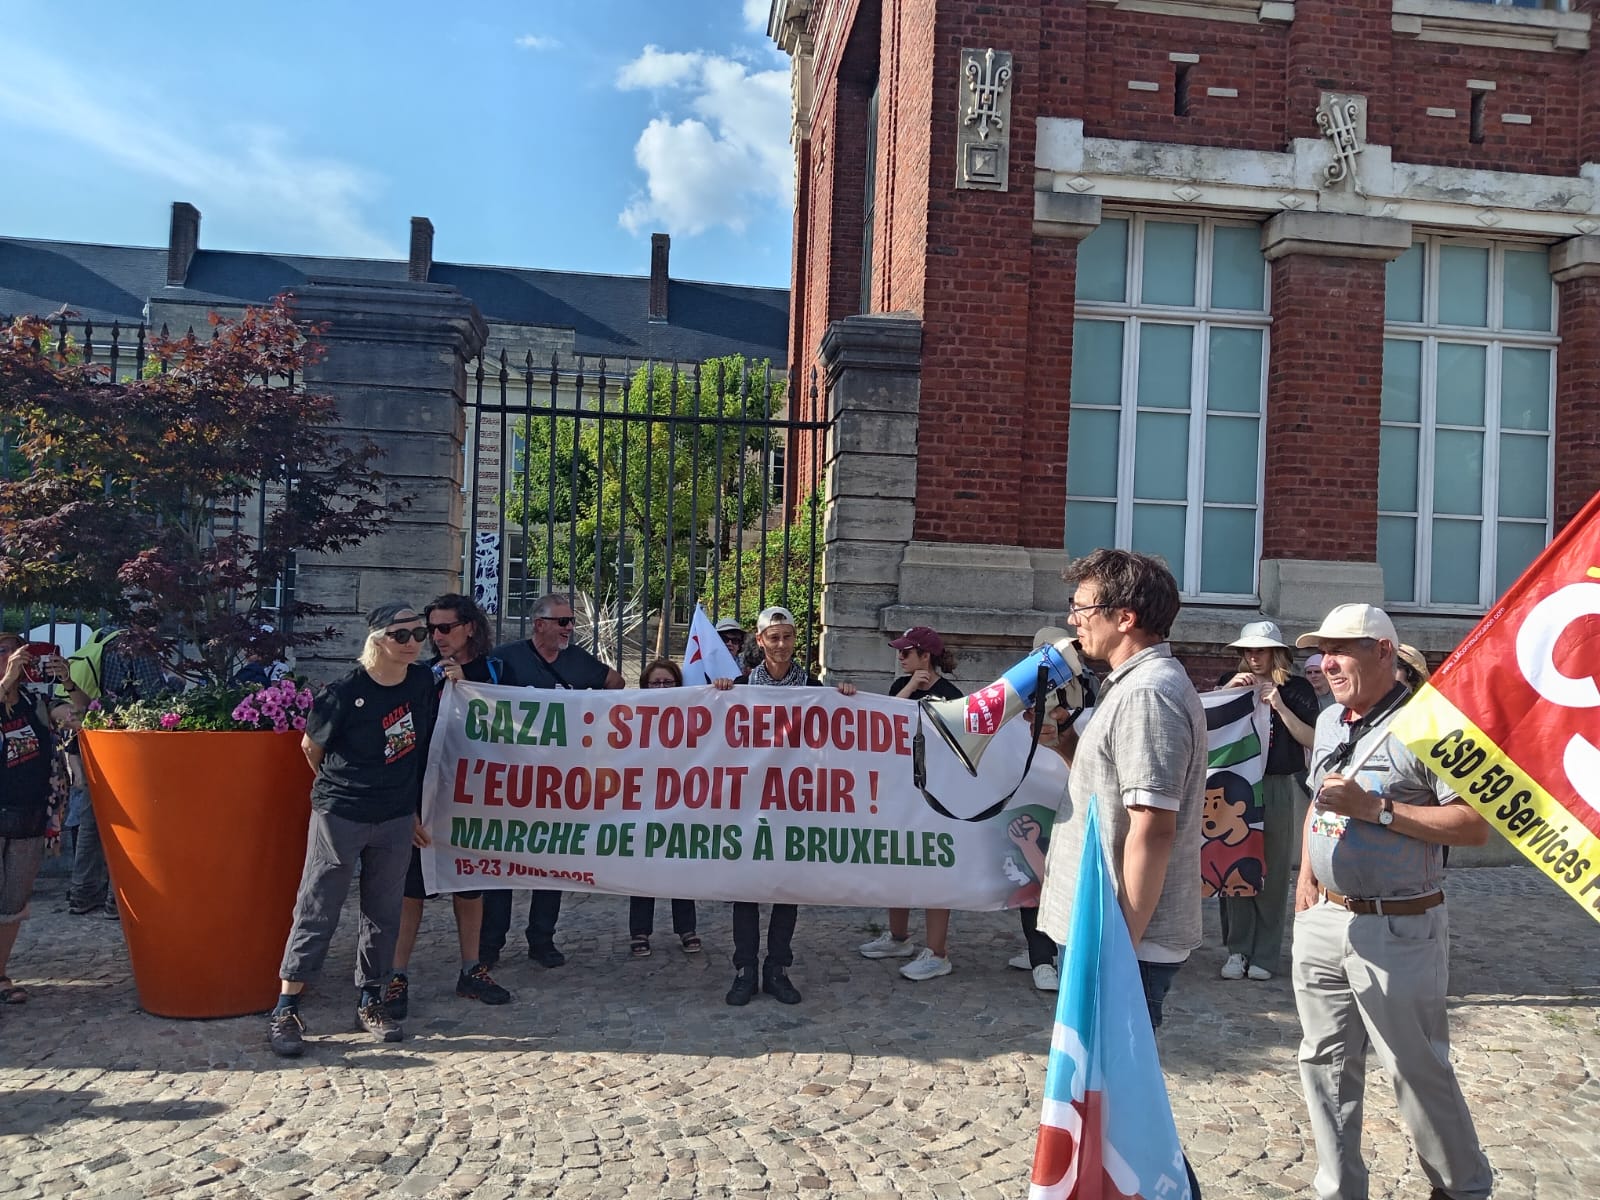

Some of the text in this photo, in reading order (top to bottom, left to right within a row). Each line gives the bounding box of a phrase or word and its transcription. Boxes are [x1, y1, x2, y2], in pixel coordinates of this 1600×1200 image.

[465, 699, 567, 748] GAZA
[607, 704, 712, 749] STOP
[725, 705, 912, 756] GENOCIDE
[453, 758, 644, 811] L'EUROPE
[654, 766, 750, 811] DOIT
[759, 766, 856, 814] AGIR
[1430, 729, 1487, 779] CSD
[1469, 764, 1514, 804] 59
[1496, 790, 1591, 884] Services
[450, 816, 956, 868] MARCHE DE PARIS À BRUXELLES
[454, 858, 502, 877] 15-23
